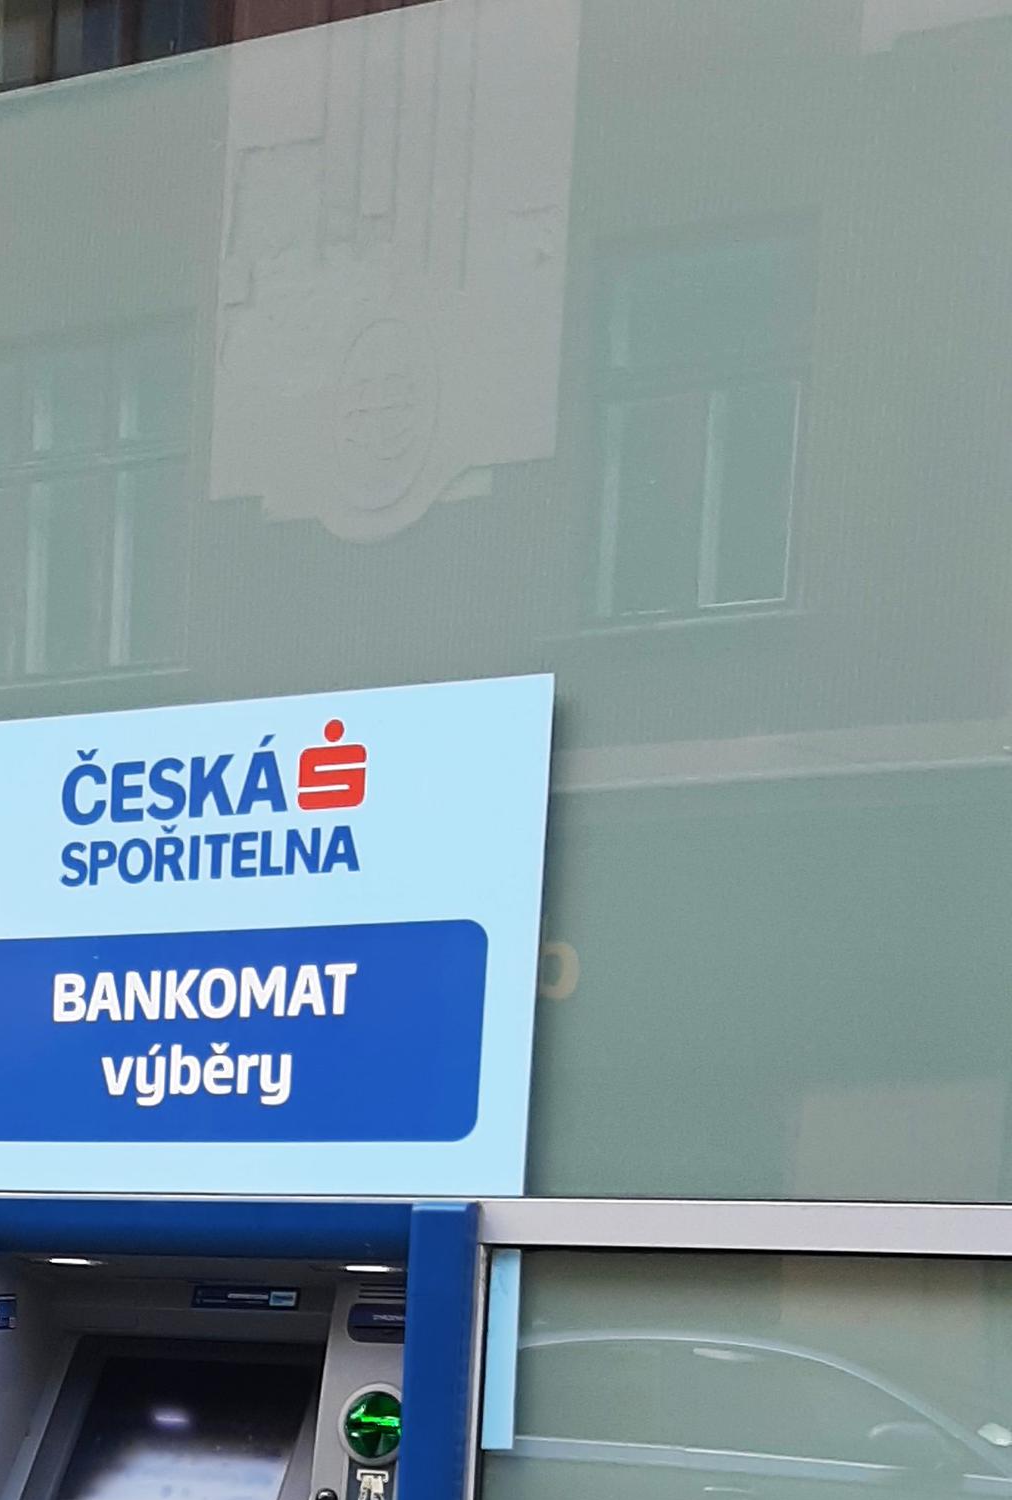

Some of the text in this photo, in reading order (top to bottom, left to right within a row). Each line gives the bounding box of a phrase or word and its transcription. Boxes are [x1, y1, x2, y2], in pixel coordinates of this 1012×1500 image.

[61, 734, 287, 826] ČESKÁ
[60, 824, 360, 887] SPOŘITELNA
[52, 962, 358, 1023] BANKOMAT
[101, 1042, 293, 1106] výběry
